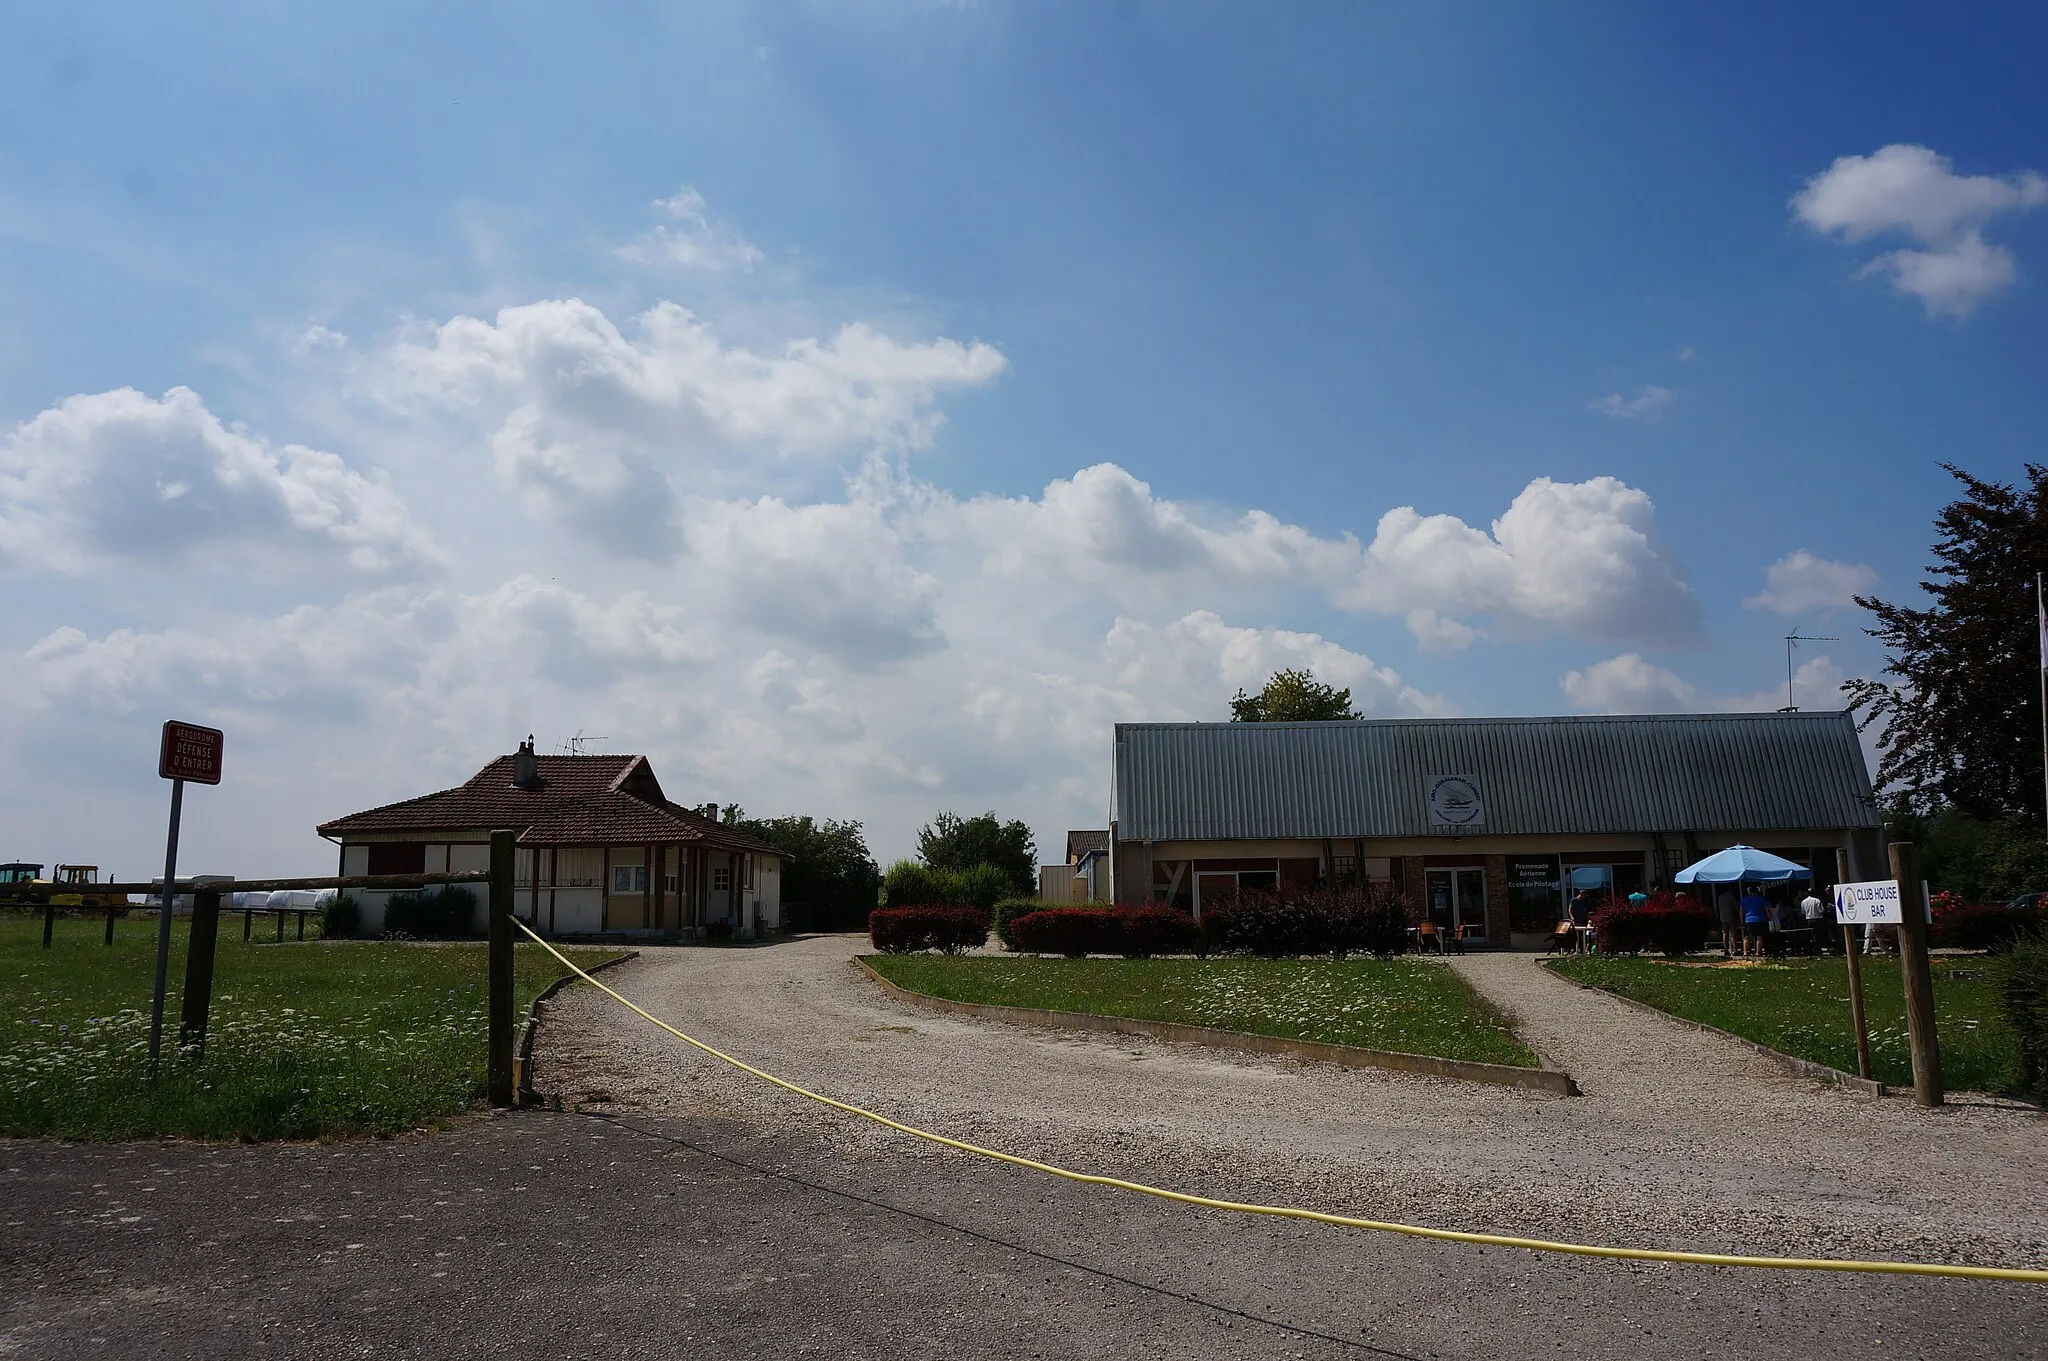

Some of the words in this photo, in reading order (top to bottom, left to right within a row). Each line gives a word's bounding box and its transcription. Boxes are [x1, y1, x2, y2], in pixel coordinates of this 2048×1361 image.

[174, 755, 212, 771] D'ENTRER
[1533, 880, 1559, 889] Pilotage
[1856, 888, 1874, 901] CLUB
[1875, 886, 1898, 900] HOUSE
[1871, 904, 1886, 917] BAR
